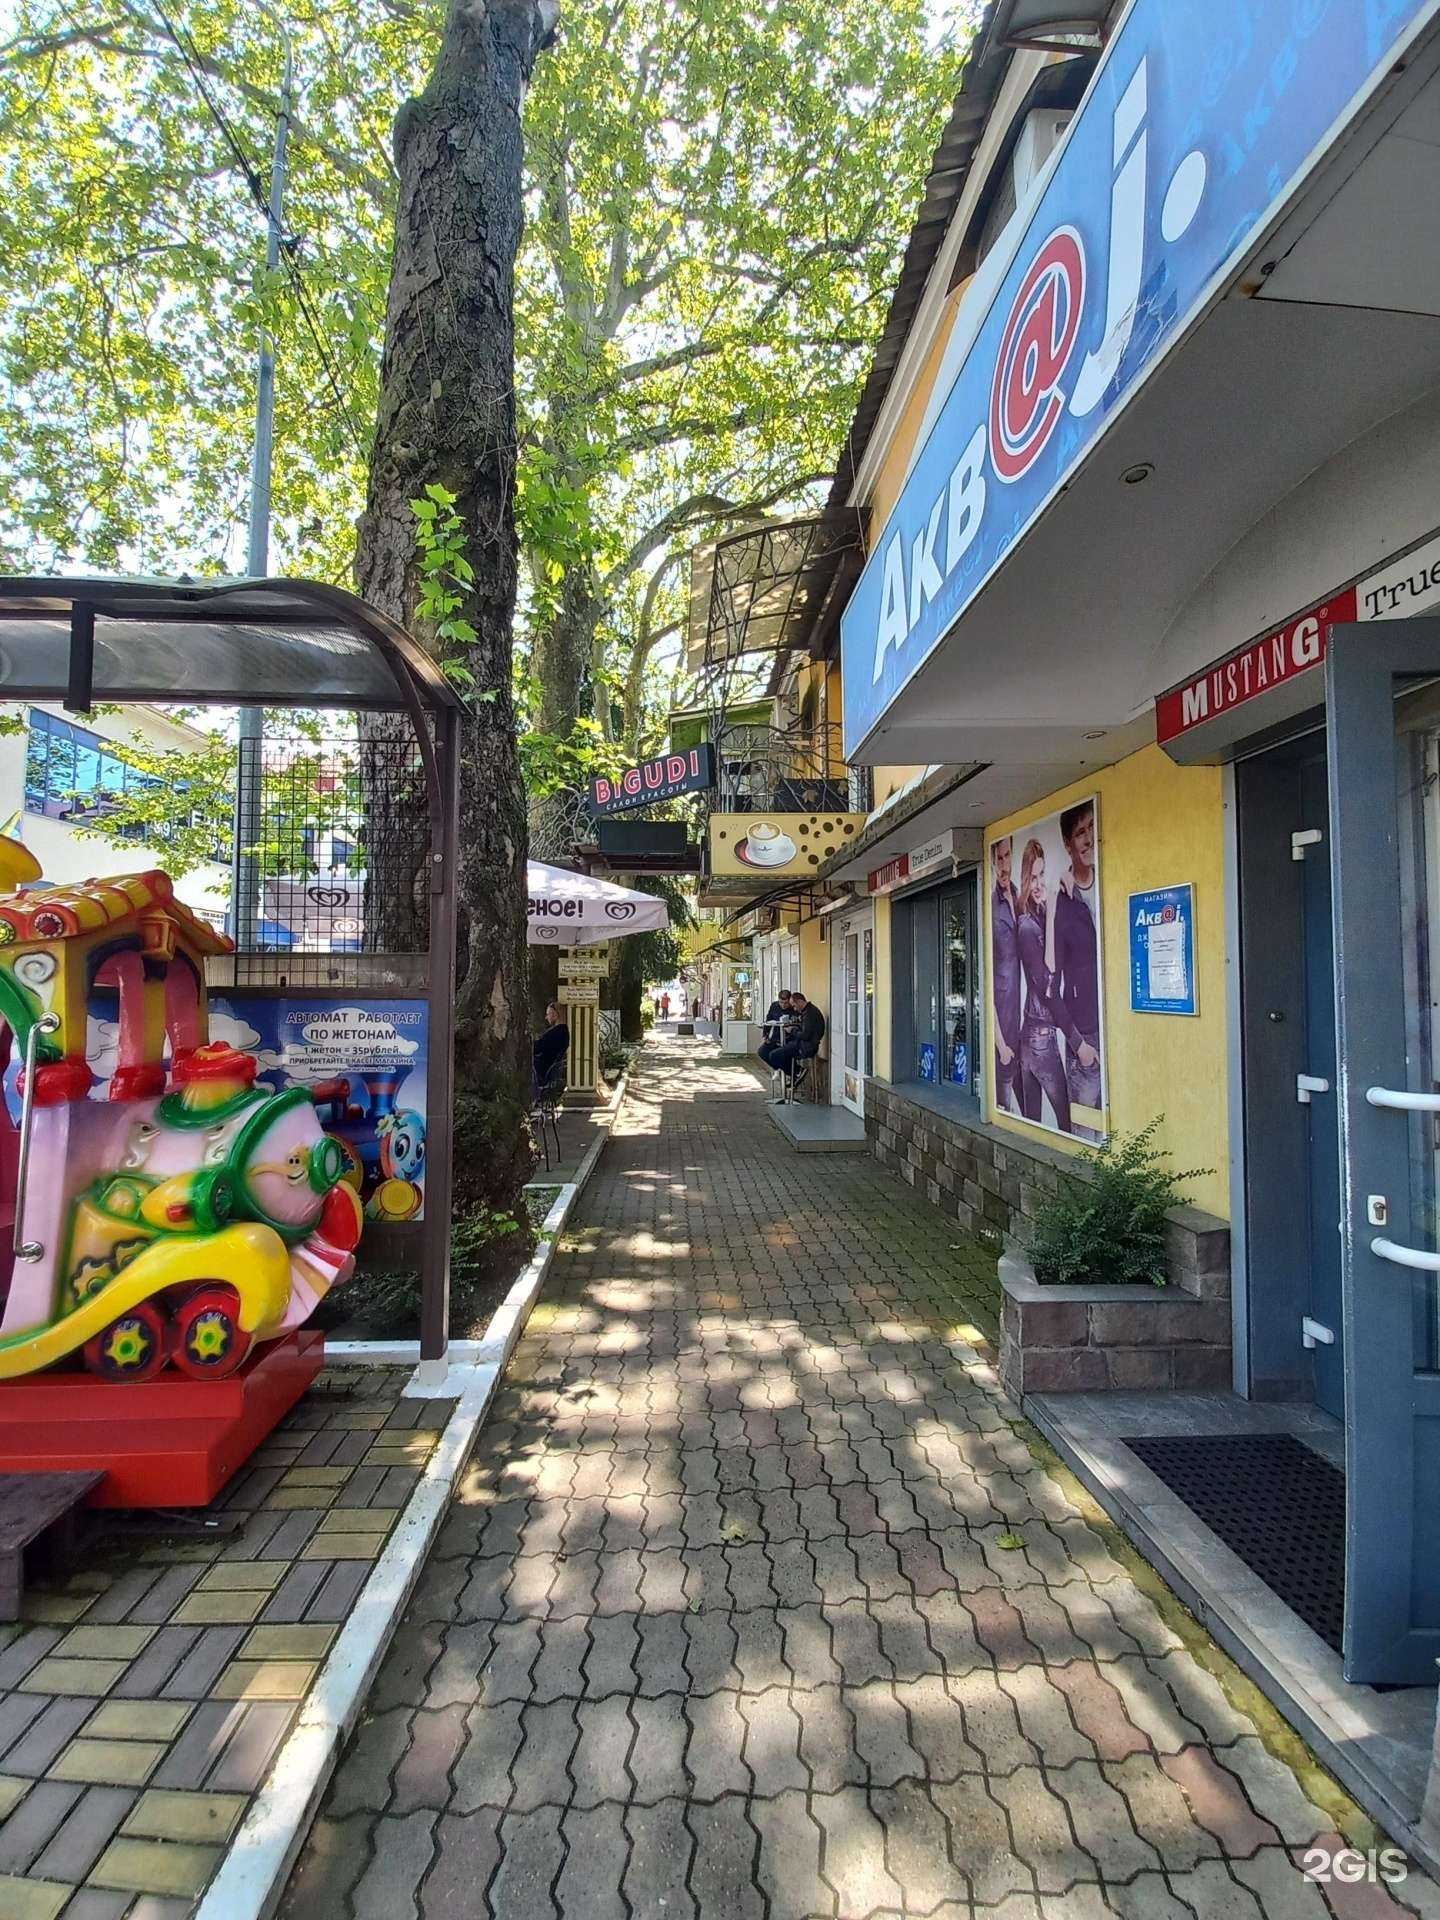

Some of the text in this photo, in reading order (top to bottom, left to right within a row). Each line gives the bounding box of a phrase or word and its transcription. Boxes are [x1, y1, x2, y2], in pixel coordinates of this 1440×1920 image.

[1182, 616, 1321, 728] MUSTANG
[595, 750, 699, 804] BIGUDI
[287, 1012, 421, 1024] АВТОМАТ РАБОТАЕТ
[310, 1029, 397, 1040] ПО ЖЕТОНАМ
[310, 1046, 342, 1054] жетон
